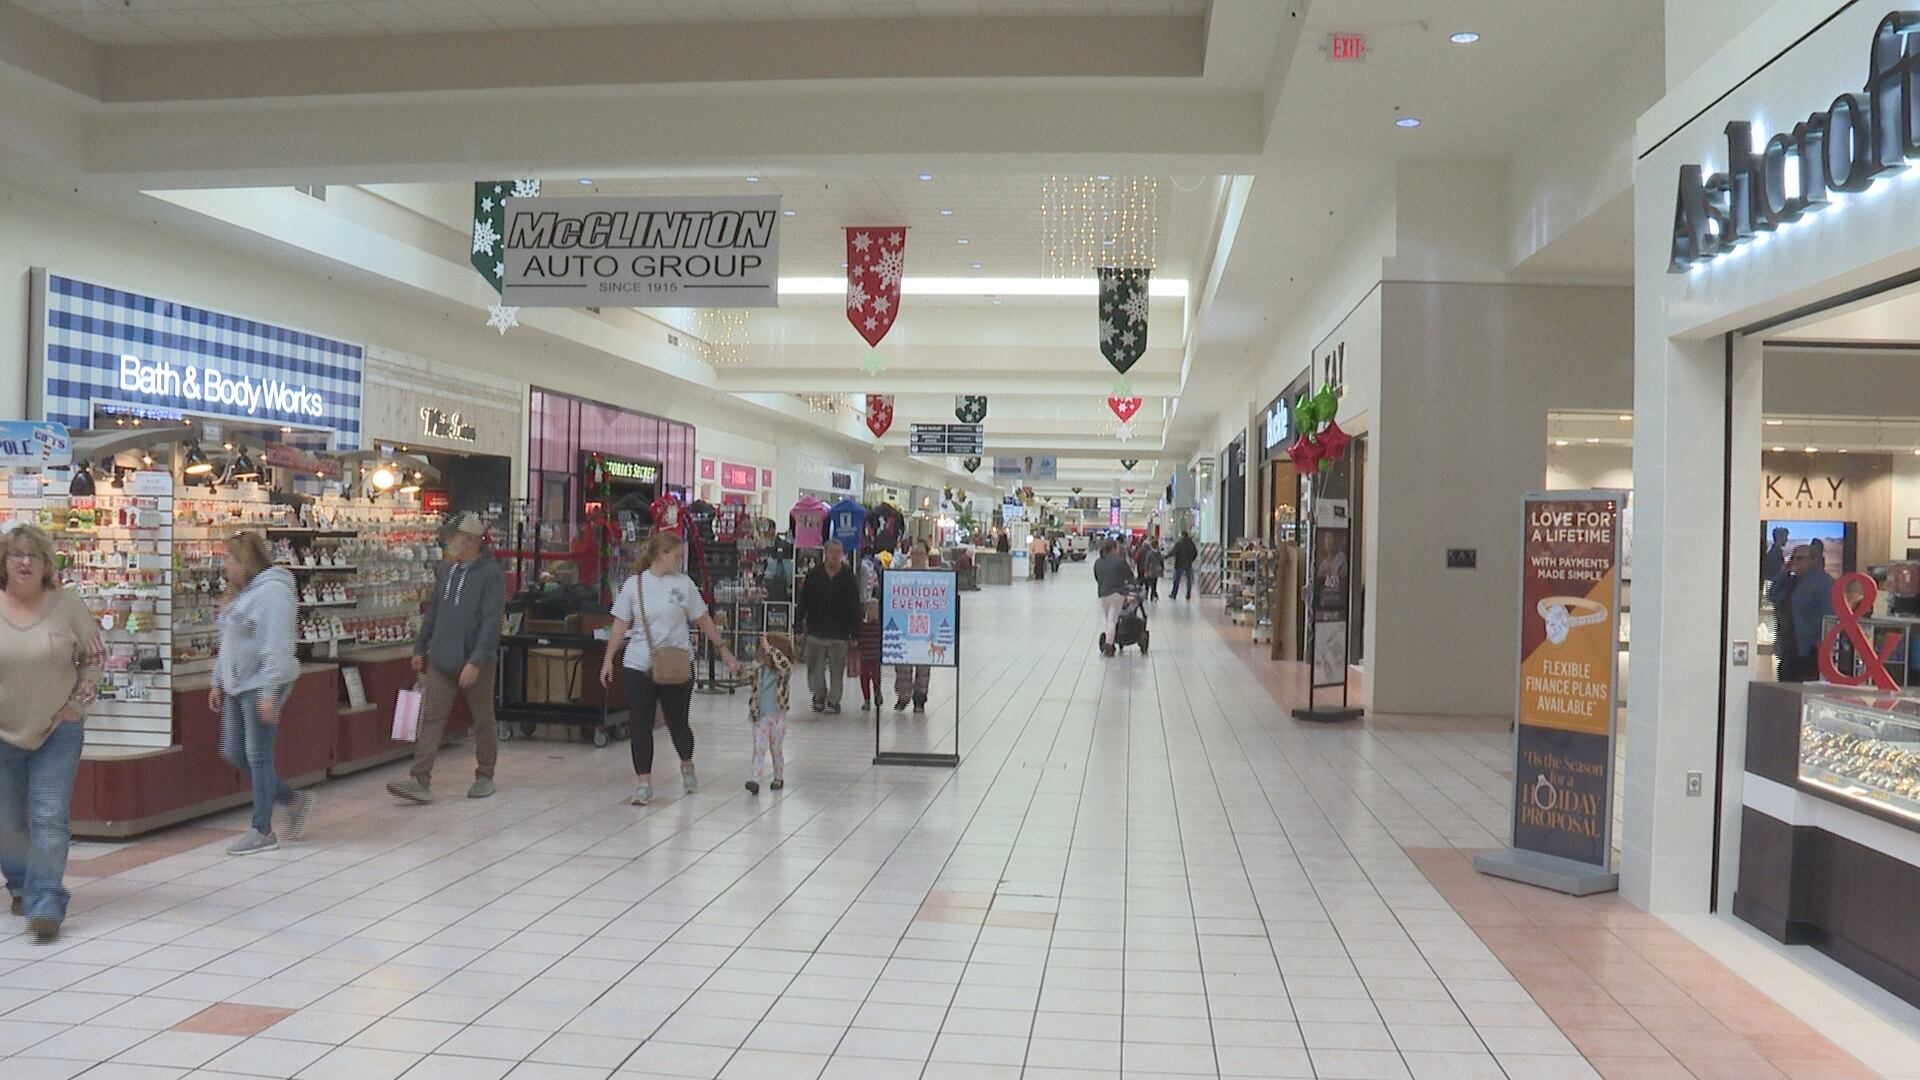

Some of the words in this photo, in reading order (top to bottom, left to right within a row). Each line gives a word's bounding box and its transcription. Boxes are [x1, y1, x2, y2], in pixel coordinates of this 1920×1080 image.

[1333, 35, 1361, 59] EXIT
[1667, 10, 1920, 273] Ashcroft
[507, 210, 776, 249] McCLINTON
[522, 255, 619, 278] AUTO
[631, 255, 763, 278] GROUP
[599, 282, 641, 292] SINCE
[647, 282, 678, 292] 1915
[119, 354, 180, 398] Bath
[182, 365, 202, 401] &
[204, 368, 262, 415] Body
[261, 377, 323, 418] Works
[1766, 475, 1845, 501] KAY
[1766, 501, 1843, 509] JEWELERS
[1532, 512, 1573, 527] LOVE
[1577, 512, 1611, 528] FOR
[1532, 530, 1542, 543] A
[1546, 529, 1611, 543] LIFETIME
[1531, 556, 1557, 567] WITH
[1559, 558, 1609, 569] PAYMENTS
[1538, 569, 1565, 580] MADE
[1567, 571, 1602, 581] SIMPLE
[892, 585, 947, 598] HOLIDAY
[1543, 660, 1591, 680] FLEXIBLE
[1526, 675, 1569, 695] FINANCE
[1572, 682, 1607, 700] PLANS
[1544, 753, 1562, 769] the
[1564, 756, 1604, 777] Season
[1550, 770, 1565, 784] for
[1521, 806, 1600, 839] PROPOSAL
